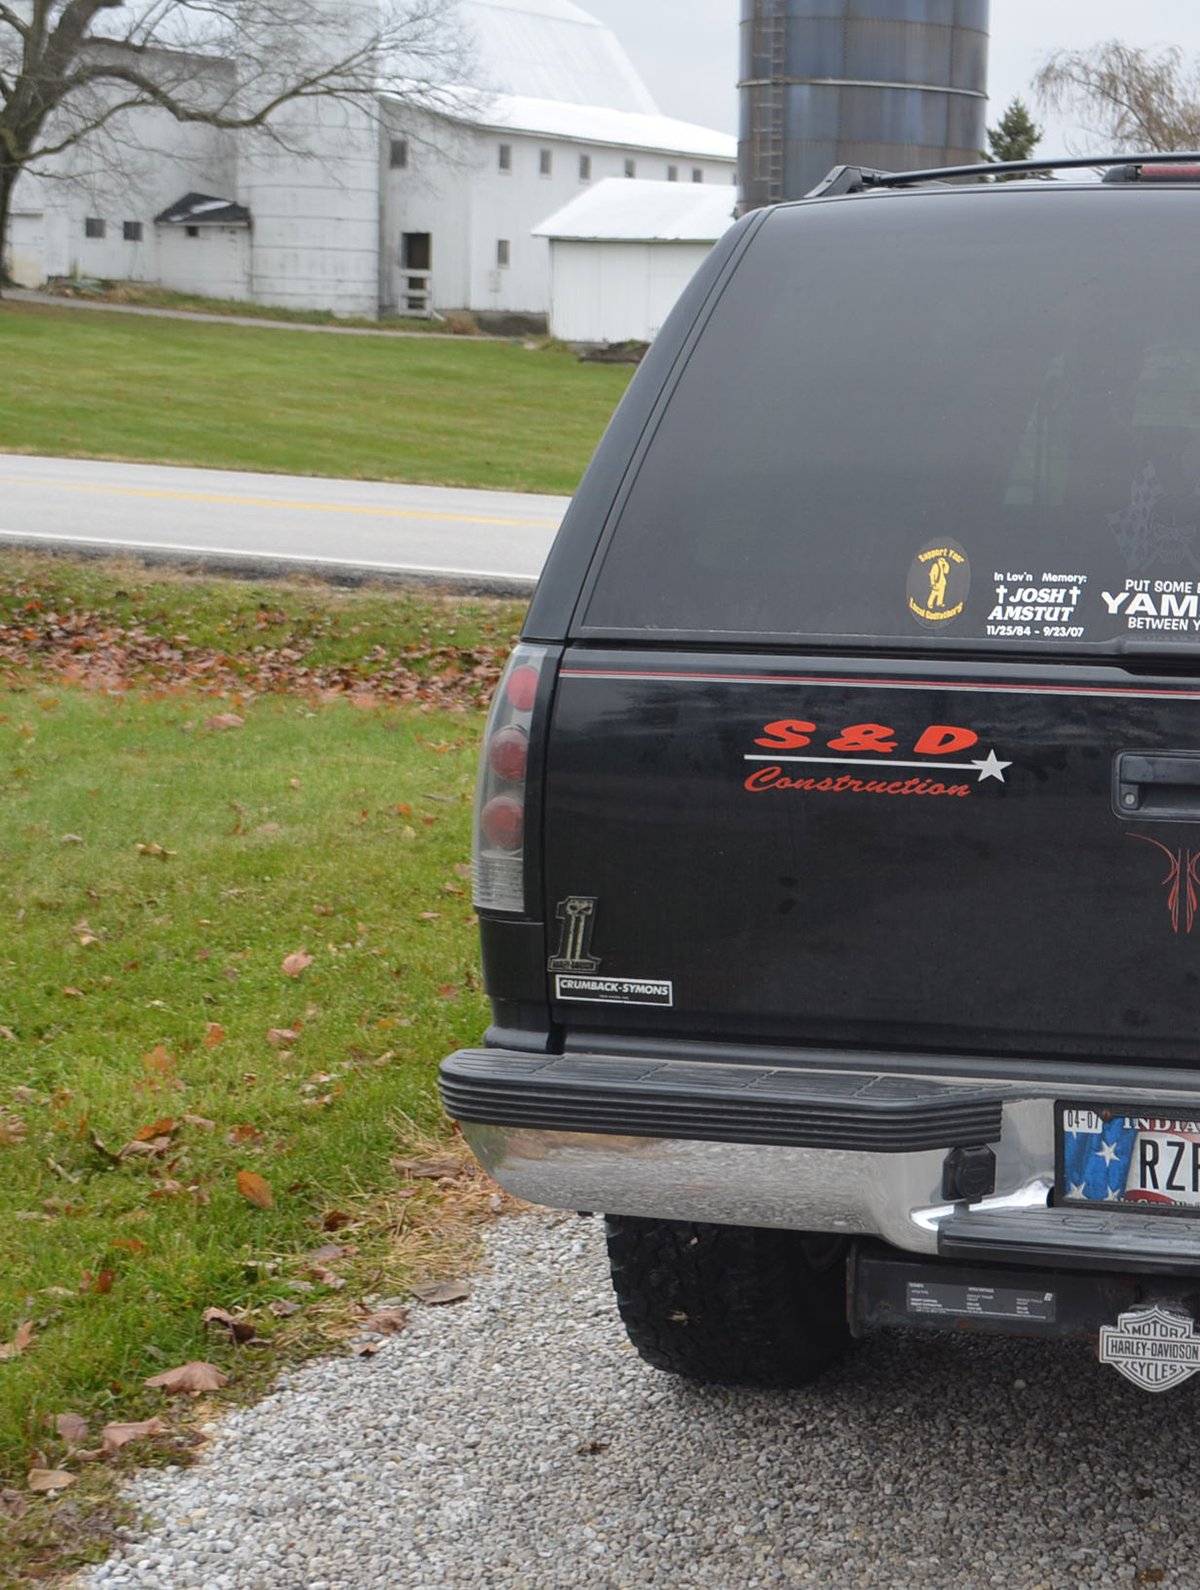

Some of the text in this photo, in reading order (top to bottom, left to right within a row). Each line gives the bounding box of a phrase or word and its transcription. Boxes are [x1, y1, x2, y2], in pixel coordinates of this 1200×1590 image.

[994, 571, 1004, 581] In
[1008, 587, 1067, 603] JOSH
[1125, 579, 1151, 591] PUT
[1154, 580, 1193, 594] SOME
[987, 605, 1075, 622] AMSTUT
[986, 625, 1031, 636] 11/25/84
[1042, 626, 1085, 637] 9/23/07
[1128, 617, 1189, 631] BETWEEN
[753, 719, 979, 755] S & D
[744, 766, 971, 797] Construction
[560, 979, 668, 996] CRUMBACK-SYMONS
[1131, 1319, 1179, 1339] MOTOR
[1110, 1338, 1200, 1361] HARLEY-DAVIDSON
[1131, 1361, 1177, 1382] CYCLES
